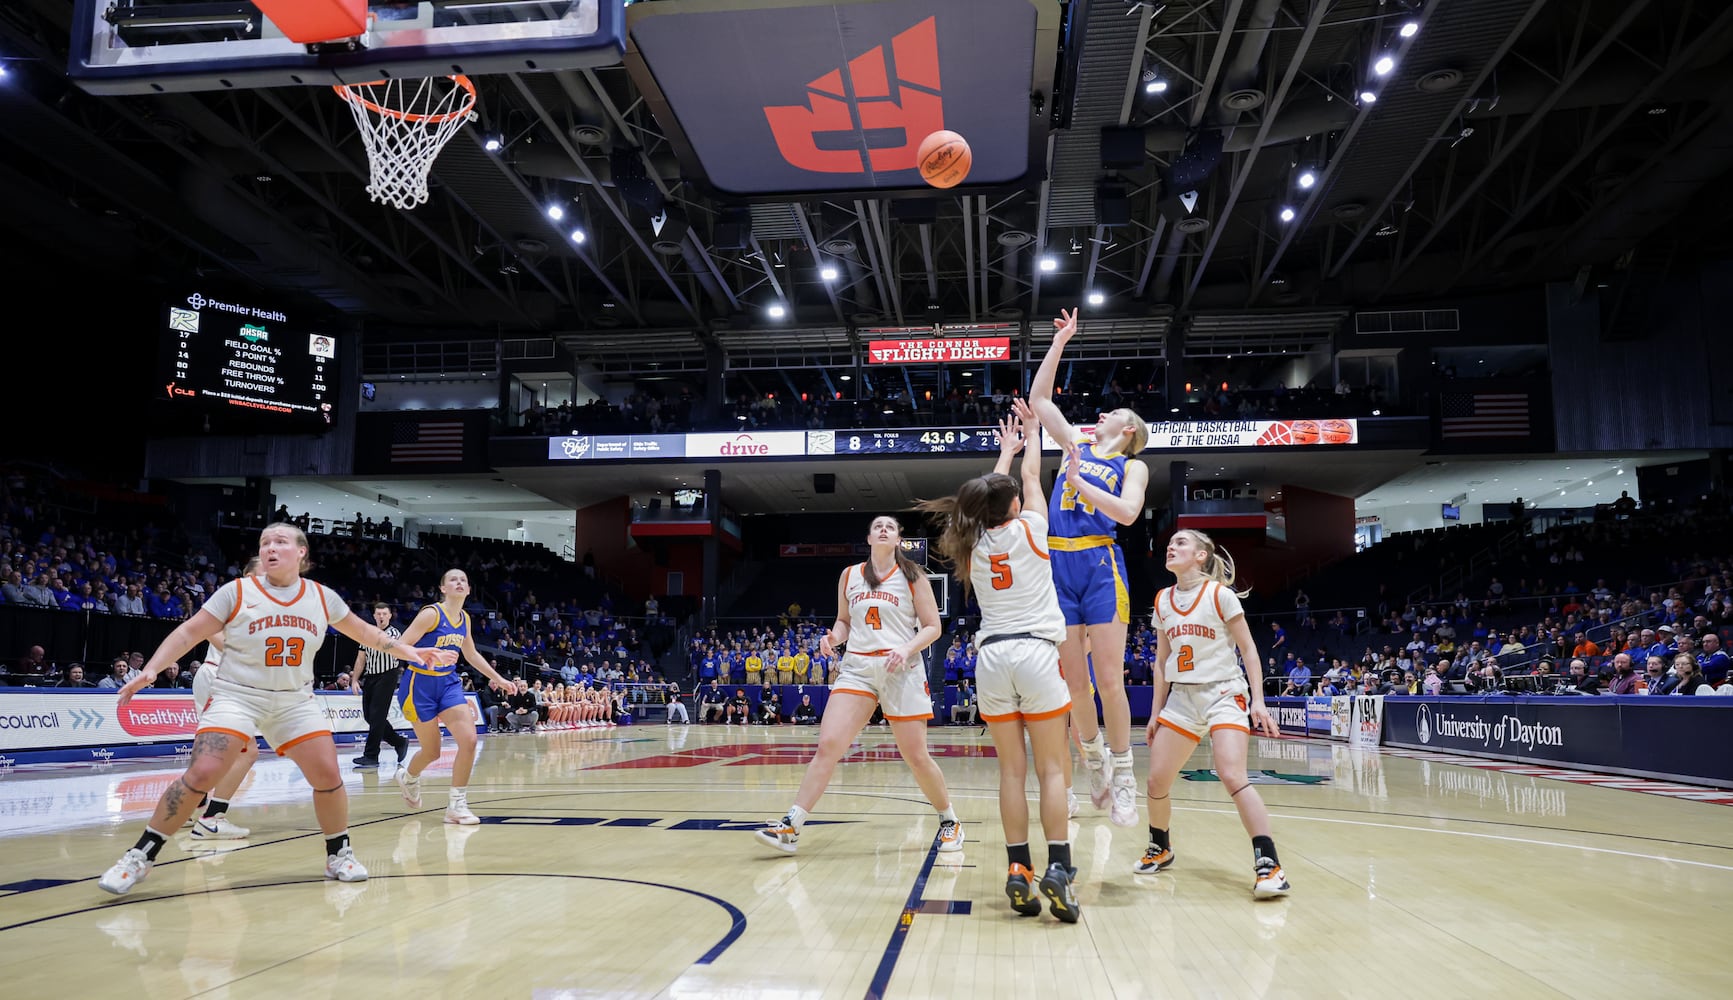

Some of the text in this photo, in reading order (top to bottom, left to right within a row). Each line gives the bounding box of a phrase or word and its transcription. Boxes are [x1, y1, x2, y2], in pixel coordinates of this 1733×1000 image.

[208, 299, 287, 322] Premier Health
[225, 340, 282, 356] FIELD GOAL %
[899, 340, 980, 349] THE CONNOR
[178, 351, 189, 359] 14
[242, 351, 267, 362] POINT
[269, 355, 276, 364] %
[882, 347, 998, 361] FLIGHT DECK
[229, 360, 275, 374] REBOUNDS
[221, 368, 284, 385] FREE THROW %
[224, 379, 275, 393] TURNOVERS
[311, 383, 326, 391] 100
[1151, 420, 1258, 434] OFFICIAL BASKETBALL
[849, 436, 861, 451] 8
[874, 439, 894, 448] 4 3
[920, 431, 955, 444] 43.6
[981, 437, 988, 446] 2
[1170, 434, 1240, 446] OF THE OHSAA
[719, 441, 769, 456] drive
[989, 552, 1013, 590] 5
[249, 614, 317, 637] STRASBURG
[864, 606, 882, 630] 4
[265, 636, 305, 667] 23
[1177, 645, 1194, 672] 2
[0, 712, 59, 729] council
[129, 709, 200, 727] healthyki
[339, 707, 362, 719] action
[1281, 708, 1306, 727] FLYERS
[1436, 713, 1563, 751] University of Dayton
